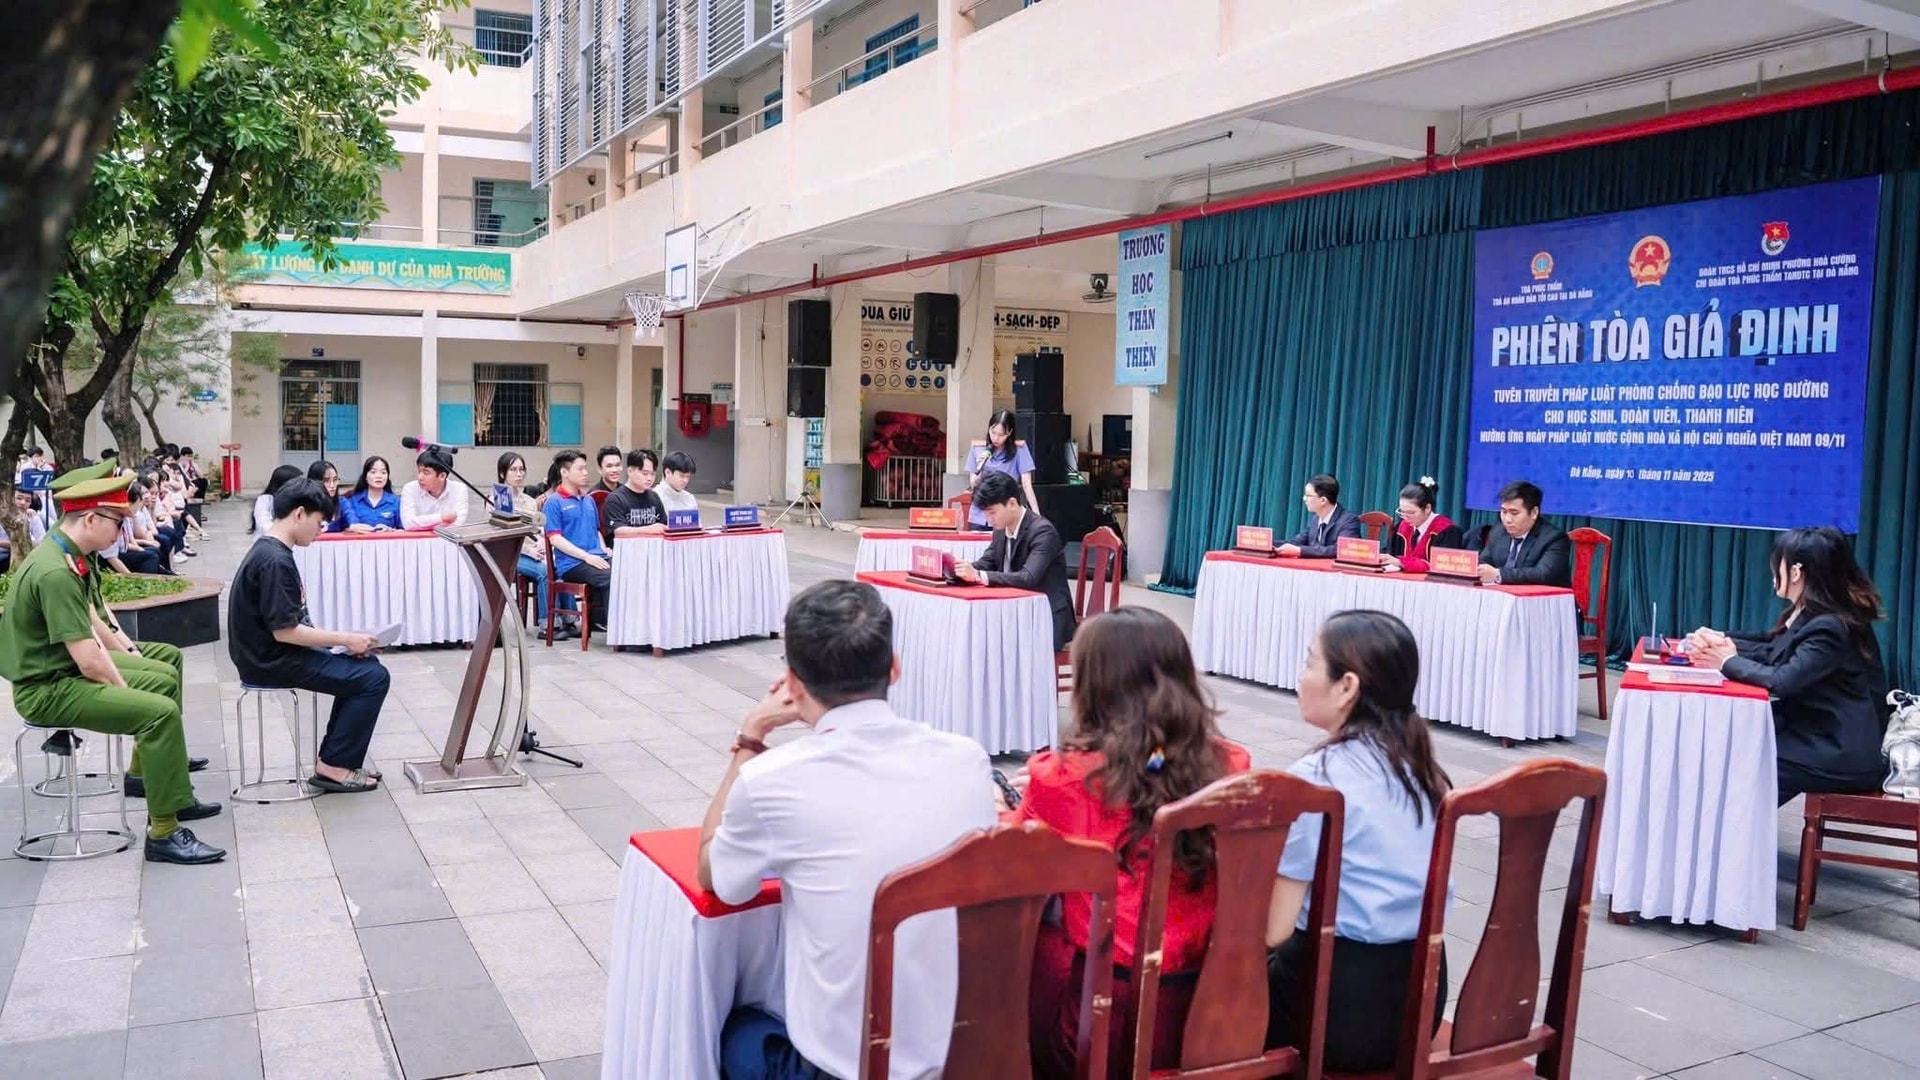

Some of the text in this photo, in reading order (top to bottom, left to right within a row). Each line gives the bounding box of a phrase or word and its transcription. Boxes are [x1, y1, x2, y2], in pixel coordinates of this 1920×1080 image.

[400, 258, 424, 278] CỦA
[428, 262, 452, 280] NHÀ
[456, 264, 506, 282] TRƯỜNG
[1132, 272, 1154, 299] HỌC
[1491, 298, 1840, 367] PHIÊN TÒA GIẢ ĐỊNH
[1494, 378, 1829, 404] TUYÊN TRUYỀN PHÁP LUẬT PHÒNG CHỐNG BẠO LỰC HỌC ĐƯỜNG
[1544, 410, 1564, 424] CHO
[1567, 410, 1587, 426] HỌC
[1621, 406, 1650, 424] ĐOÀN
[1686, 408, 1722, 424] THANH
[1726, 405, 1754, 424] NIÊN
[1508, 428, 1524, 443] ỨNG
[1526, 428, 1546, 443] NGÀY
[1548, 429, 1570, 443] PHÁP
[1572, 429, 1590, 446] LUẬT
[1594, 430, 1618, 444] NƯỚC
[1620, 430, 1644, 446] CỘNG
[1647, 430, 1666, 444] HOÀ
[1668, 430, 1680, 445] XÃ
[1683, 430, 1700, 447] HỘI
[1702, 428, 1723, 445] CHỦ
[1726, 430, 1757, 446] NGHĨA
[1760, 430, 1783, 448] VIỆT
[1786, 432, 1812, 446] NAM
[1815, 433, 1845, 448] 09/11
[1570, 466, 1580, 478] Đà
[1605, 467, 1625, 480] ngày
[1638, 468, 1662, 481] tháng
[1673, 469, 1692, 481] năm
[1693, 470, 1714, 482] 2025
